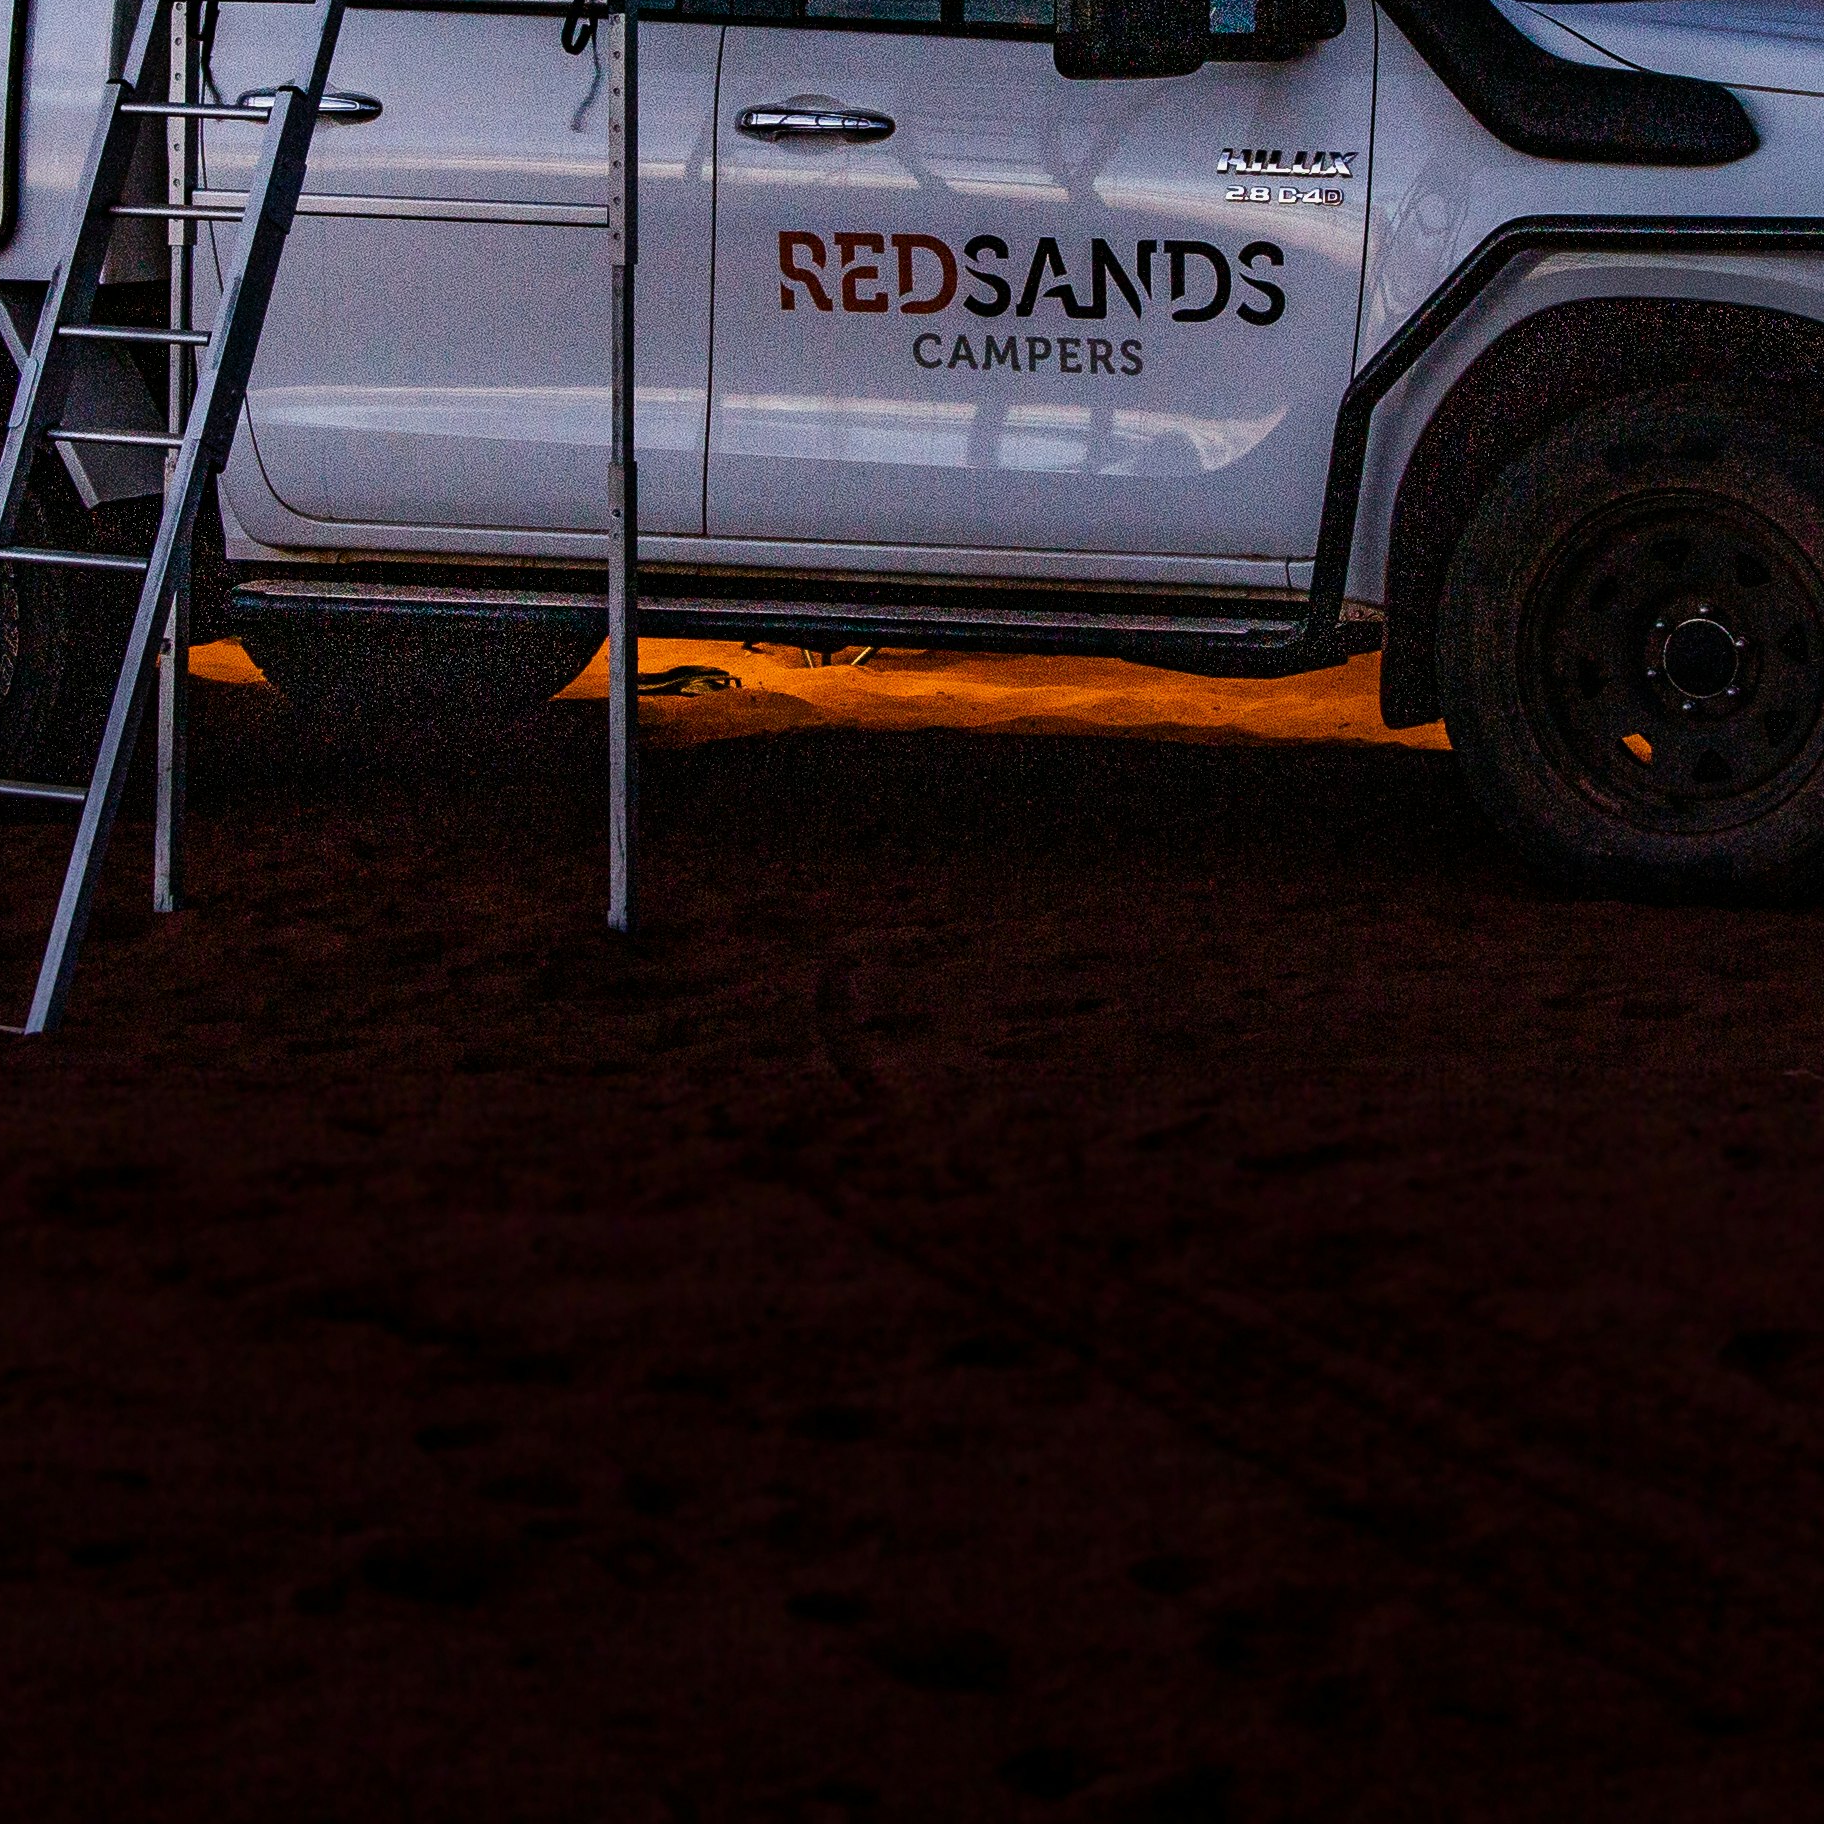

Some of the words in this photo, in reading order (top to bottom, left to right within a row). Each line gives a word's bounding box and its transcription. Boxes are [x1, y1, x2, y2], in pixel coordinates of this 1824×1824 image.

[1216, 147, 1359, 178] HILUX
[1225, 185, 1271, 203] 2.8
[1277, 186, 1345, 207] D-4D
[778, 231, 1286, 326] REDSANDS
[912, 333, 1144, 376] CAMPERS
